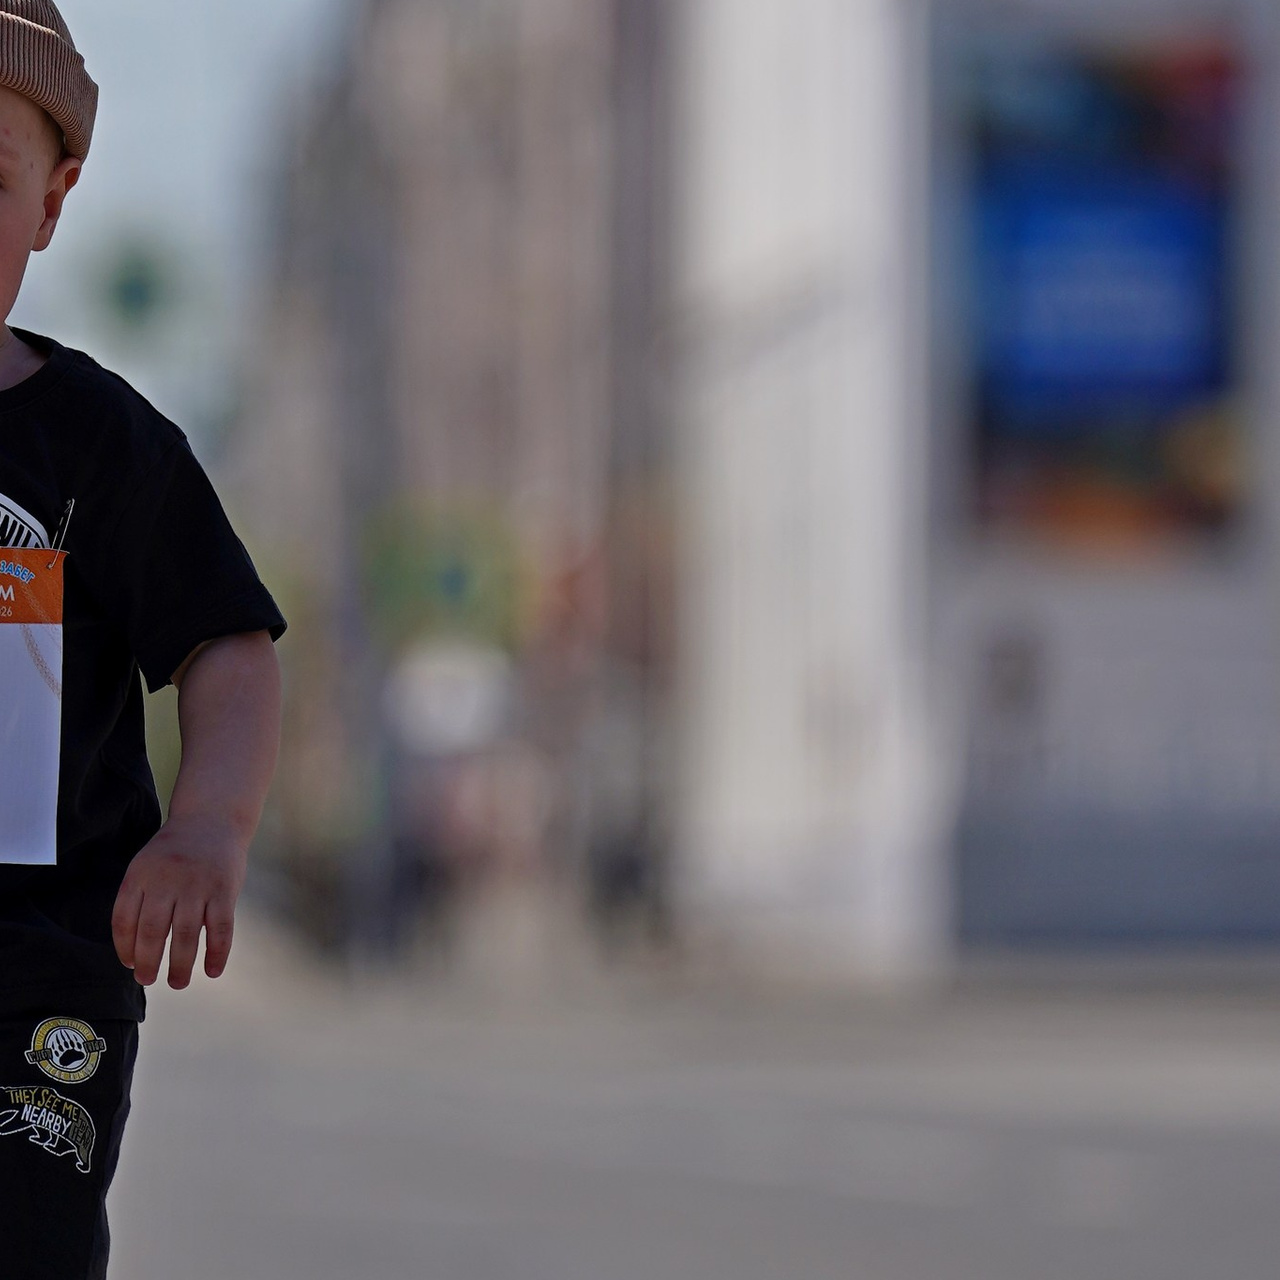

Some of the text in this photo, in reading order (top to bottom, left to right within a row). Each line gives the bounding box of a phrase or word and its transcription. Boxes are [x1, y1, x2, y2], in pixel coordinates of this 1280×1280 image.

[0, 561, 36, 583] ЗАБЕГ
[5, 1087, 79, 1121] THEY SEE ME
[21, 1104, 72, 1136] NEARBY
